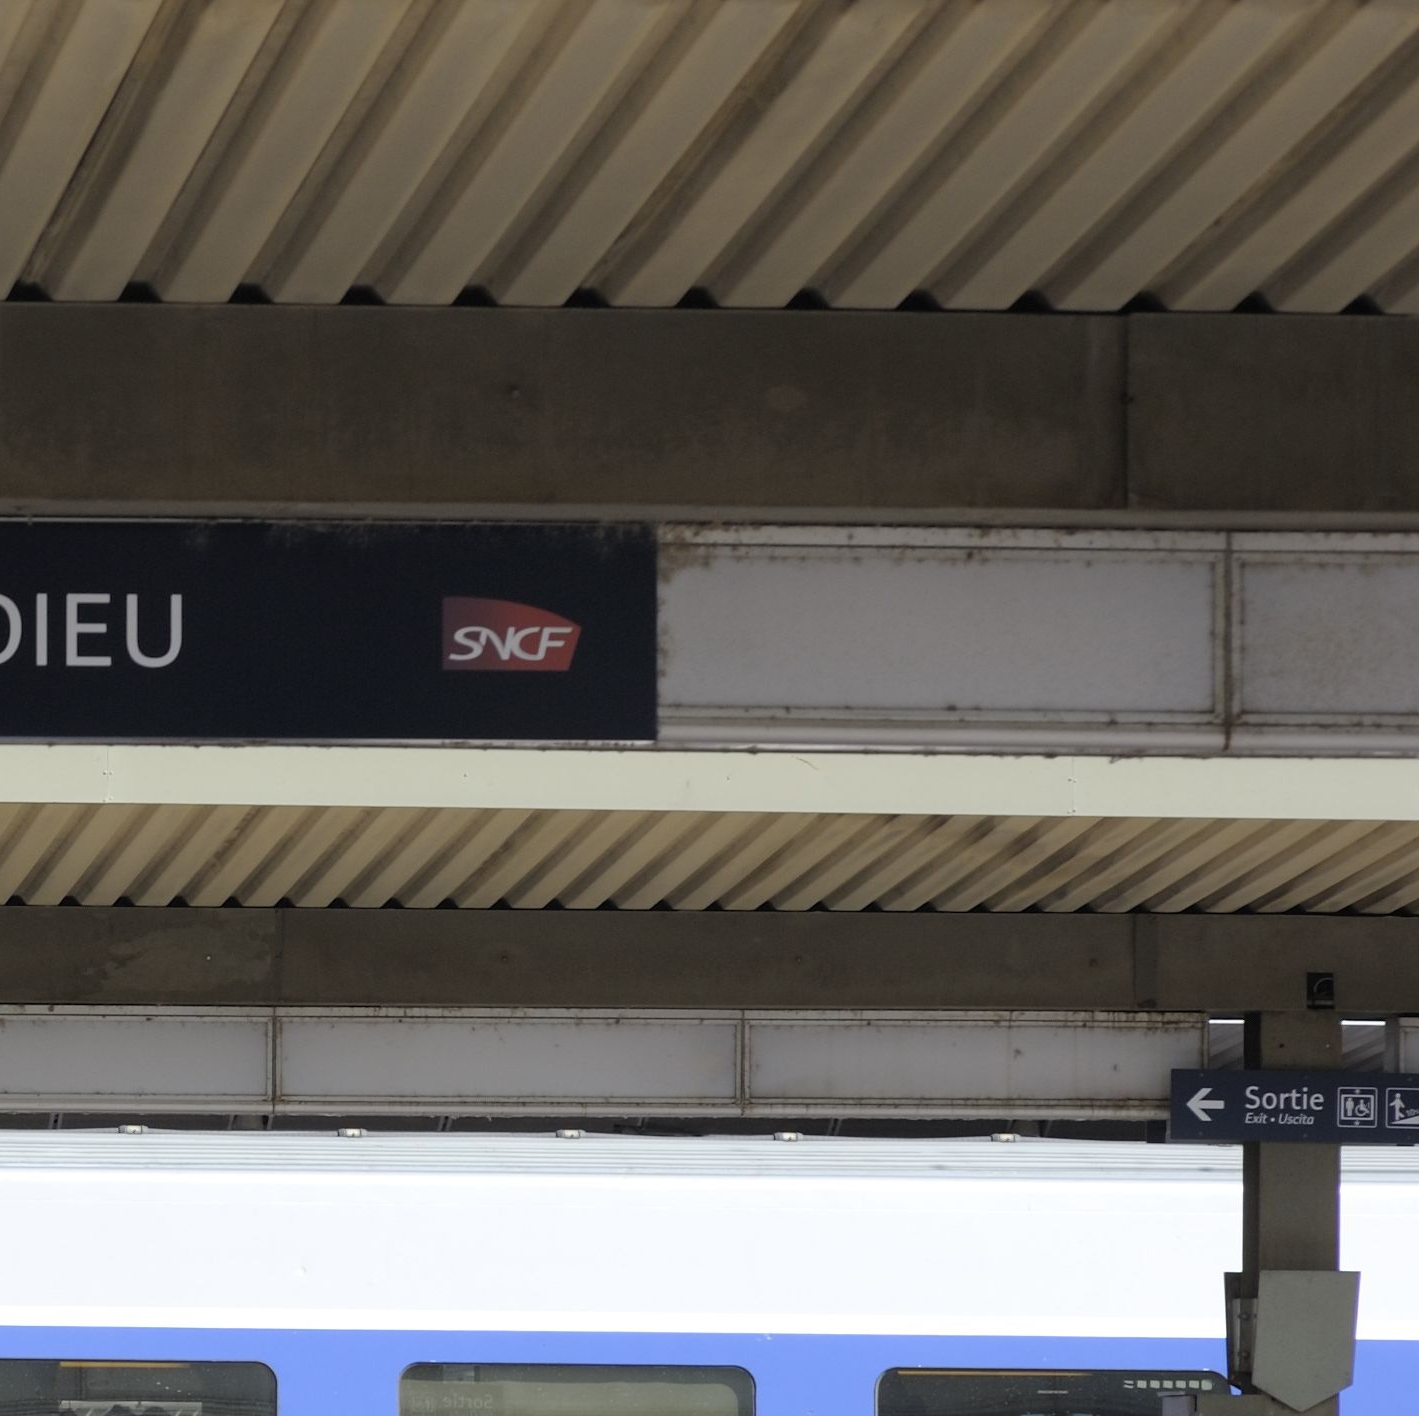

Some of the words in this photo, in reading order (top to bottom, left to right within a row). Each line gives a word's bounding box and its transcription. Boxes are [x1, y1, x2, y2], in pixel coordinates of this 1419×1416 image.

[447, 625, 574, 662] SNCF
[1244, 1085, 1325, 1111] Sortie
[1244, 1112, 1268, 1125] Exit
[1277, 1112, 1315, 1126] Uscita
